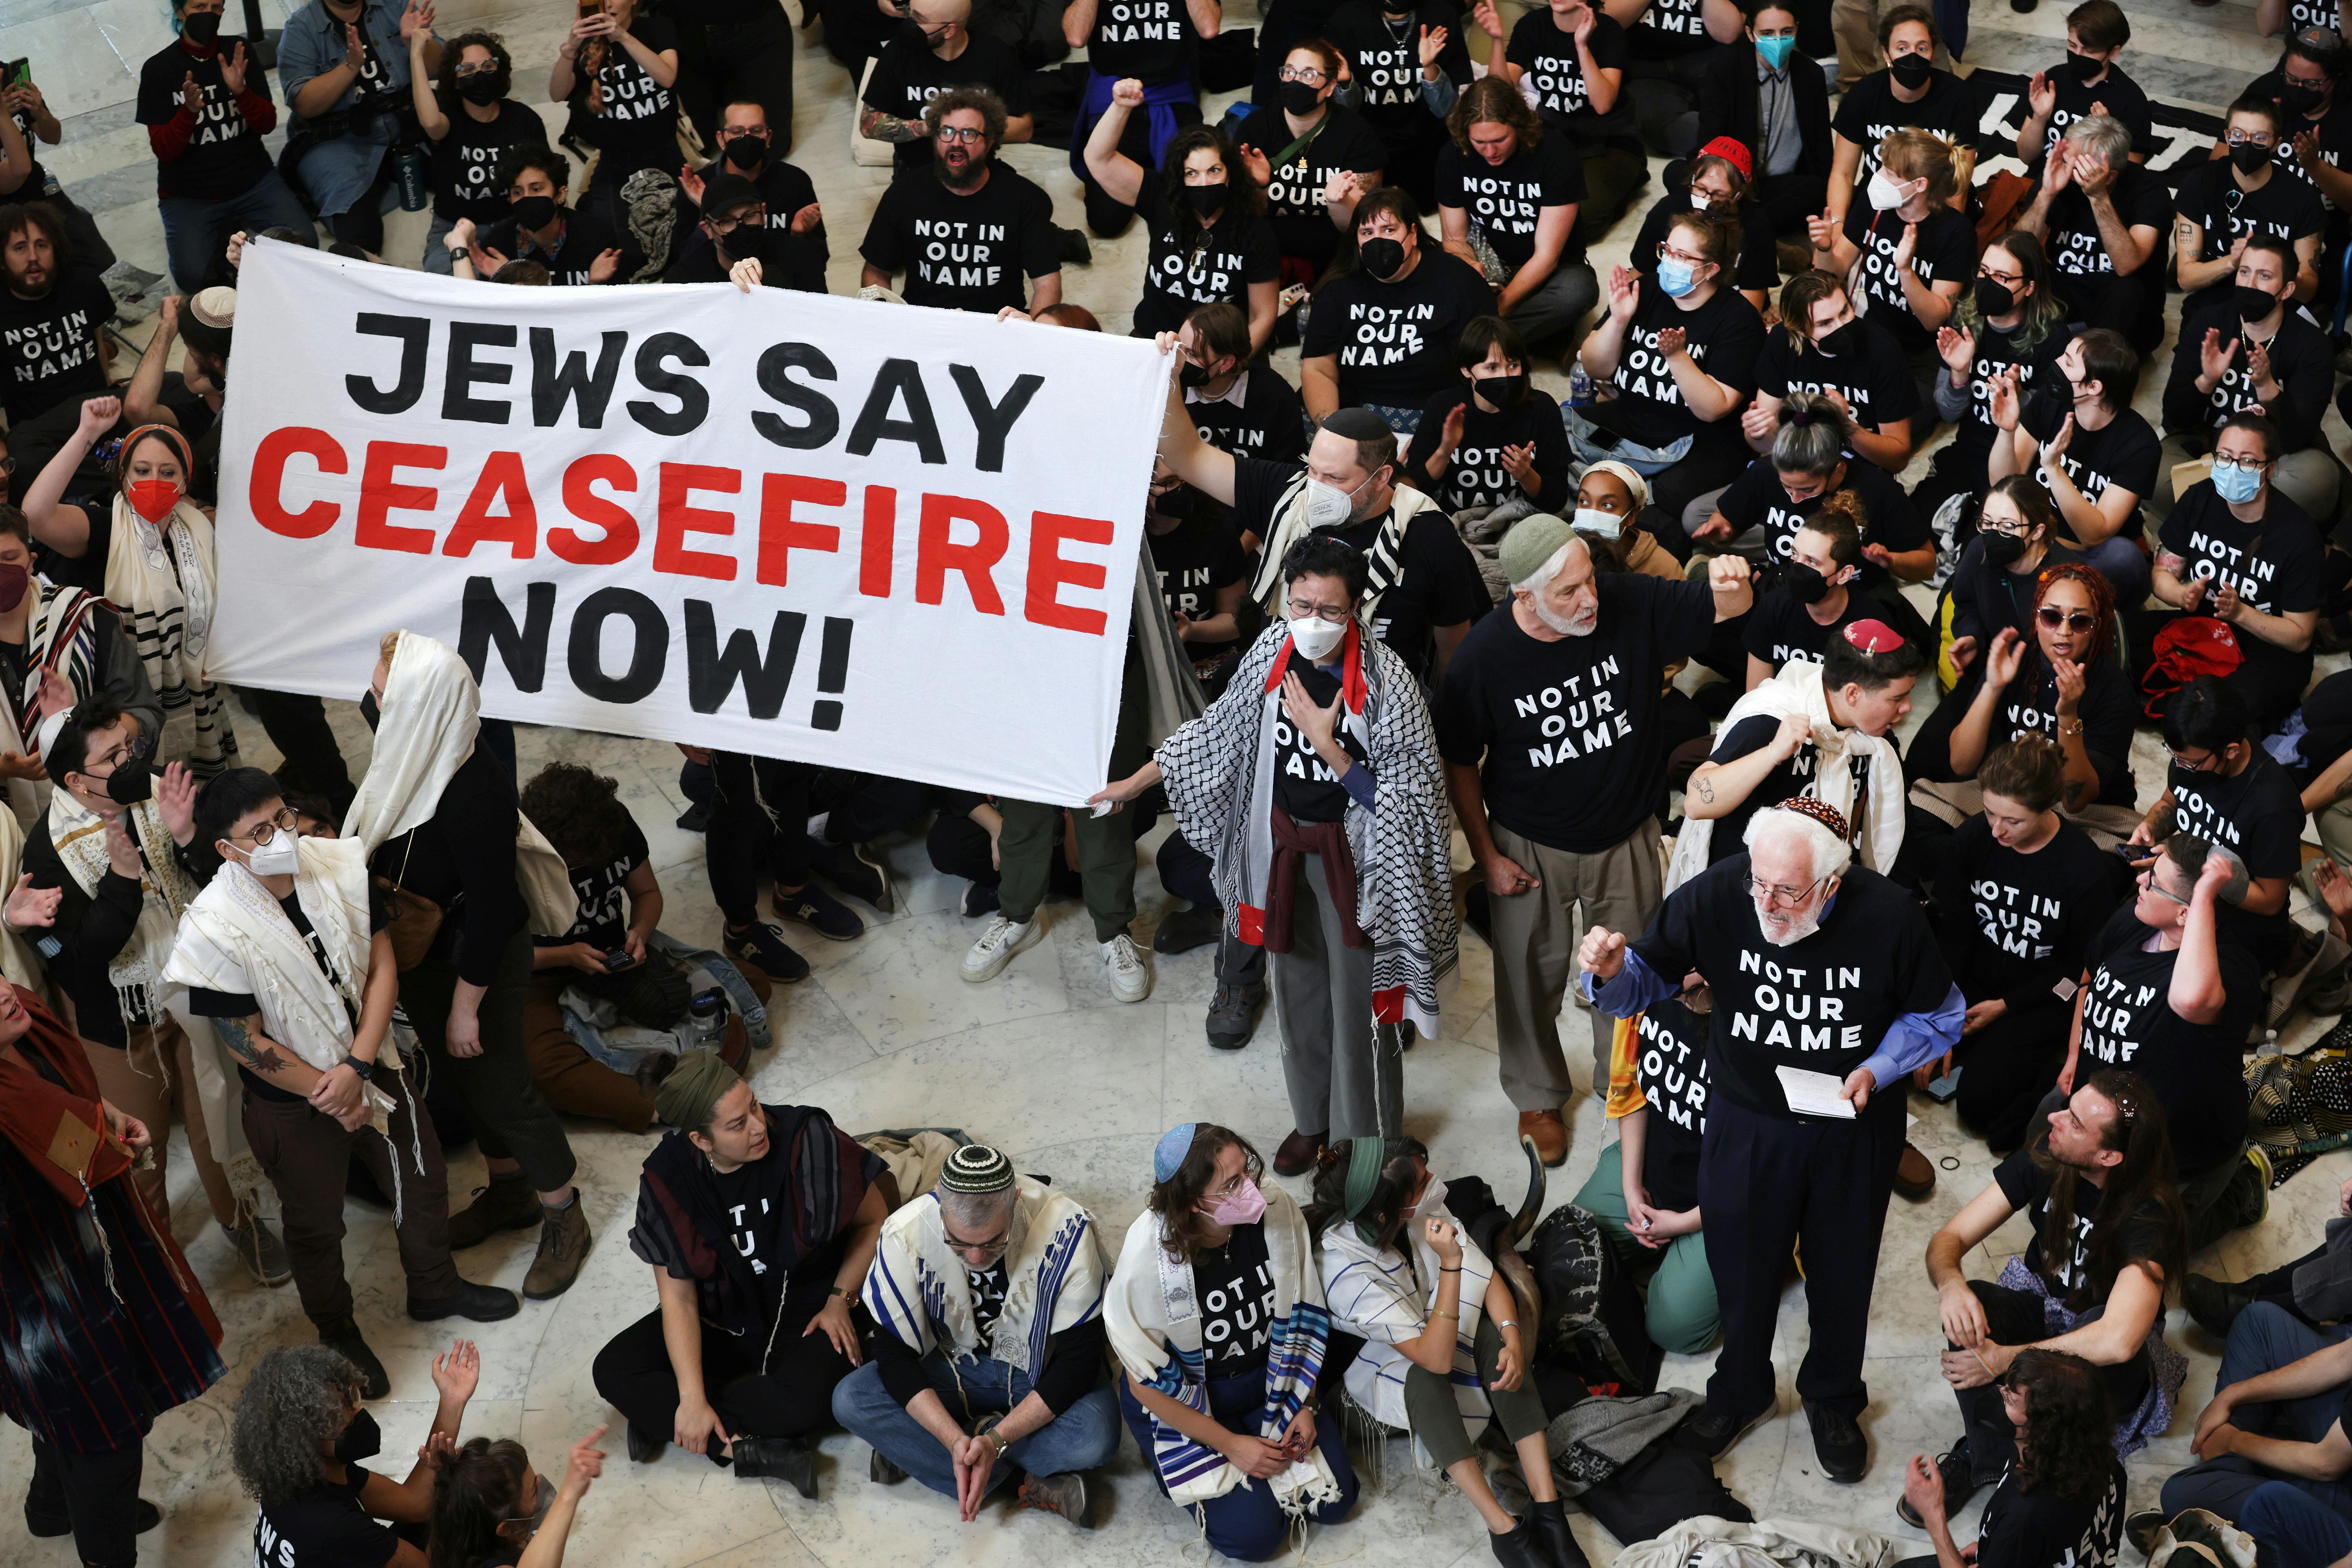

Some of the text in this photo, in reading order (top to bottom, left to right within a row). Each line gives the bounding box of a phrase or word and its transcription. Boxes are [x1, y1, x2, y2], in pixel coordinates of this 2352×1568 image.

[1112, 2, 1169, 21] OUR
[1639, 12, 1704, 36] AME
[1103, 22, 1180, 42] NAME
[1360, 50, 1408, 65] NOT
[173, 85, 216, 105] NT
[1365, 87, 1421, 104] NAM
[187, 120, 247, 145] AM
[1273, 164, 1307, 184] OT
[405, 173, 416, 208] Columbia
[1268, 182, 1327, 205] OUR
[1464, 177, 1541, 198] NOT IN
[1477, 196, 1536, 217] OUR
[916, 220, 1004, 241] NOT IN
[2056, 232, 2096, 252] NOT
[927, 242, 989, 262] OUR
[1218, 254, 1243, 270] IN
[919, 260, 1000, 286] NAME
[1164, 254, 1229, 293] OUR
[1867, 254, 1900, 285] OU
[5, 310, 87, 347] NOT IN
[1357, 324, 1417, 344] OUR
[1632, 325, 1660, 348] NO
[23, 328, 83, 360] OUR
[1341, 337, 1423, 365] NAME
[14, 339, 95, 381] NAME
[1630, 350, 1671, 377] OU
[1971, 359, 2005, 377] OT
[345, 312, 1045, 473] JEWS SAY
[1614, 365, 1689, 405] NAM
[2222, 368, 2252, 391] OT
[1844, 387, 1868, 403] IN
[1238, 429, 1264, 446] IN
[249, 426, 1115, 636] CEASEFIRE
[1767, 507, 1805, 534] NO
[2189, 531, 2275, 583] NOT IN
[1184, 568, 1209, 587] IN
[2190, 558, 2259, 601] OUR
[457, 575, 853, 732] NOW!
[1514, 655, 1619, 719] NOT IN
[1541, 690, 1614, 739] OUR
[1527, 708, 1632, 767] NAME
[2174, 786, 2239, 845] NOT IN
[606, 856, 630, 884] IN
[2031, 895, 2060, 920] IN
[1740, 950, 1860, 990] NOT IN
[1754, 984, 1844, 1022] OUR
[1639, 1016, 1690, 1062] NOT
[1731, 1011, 1862, 1051] NAME
